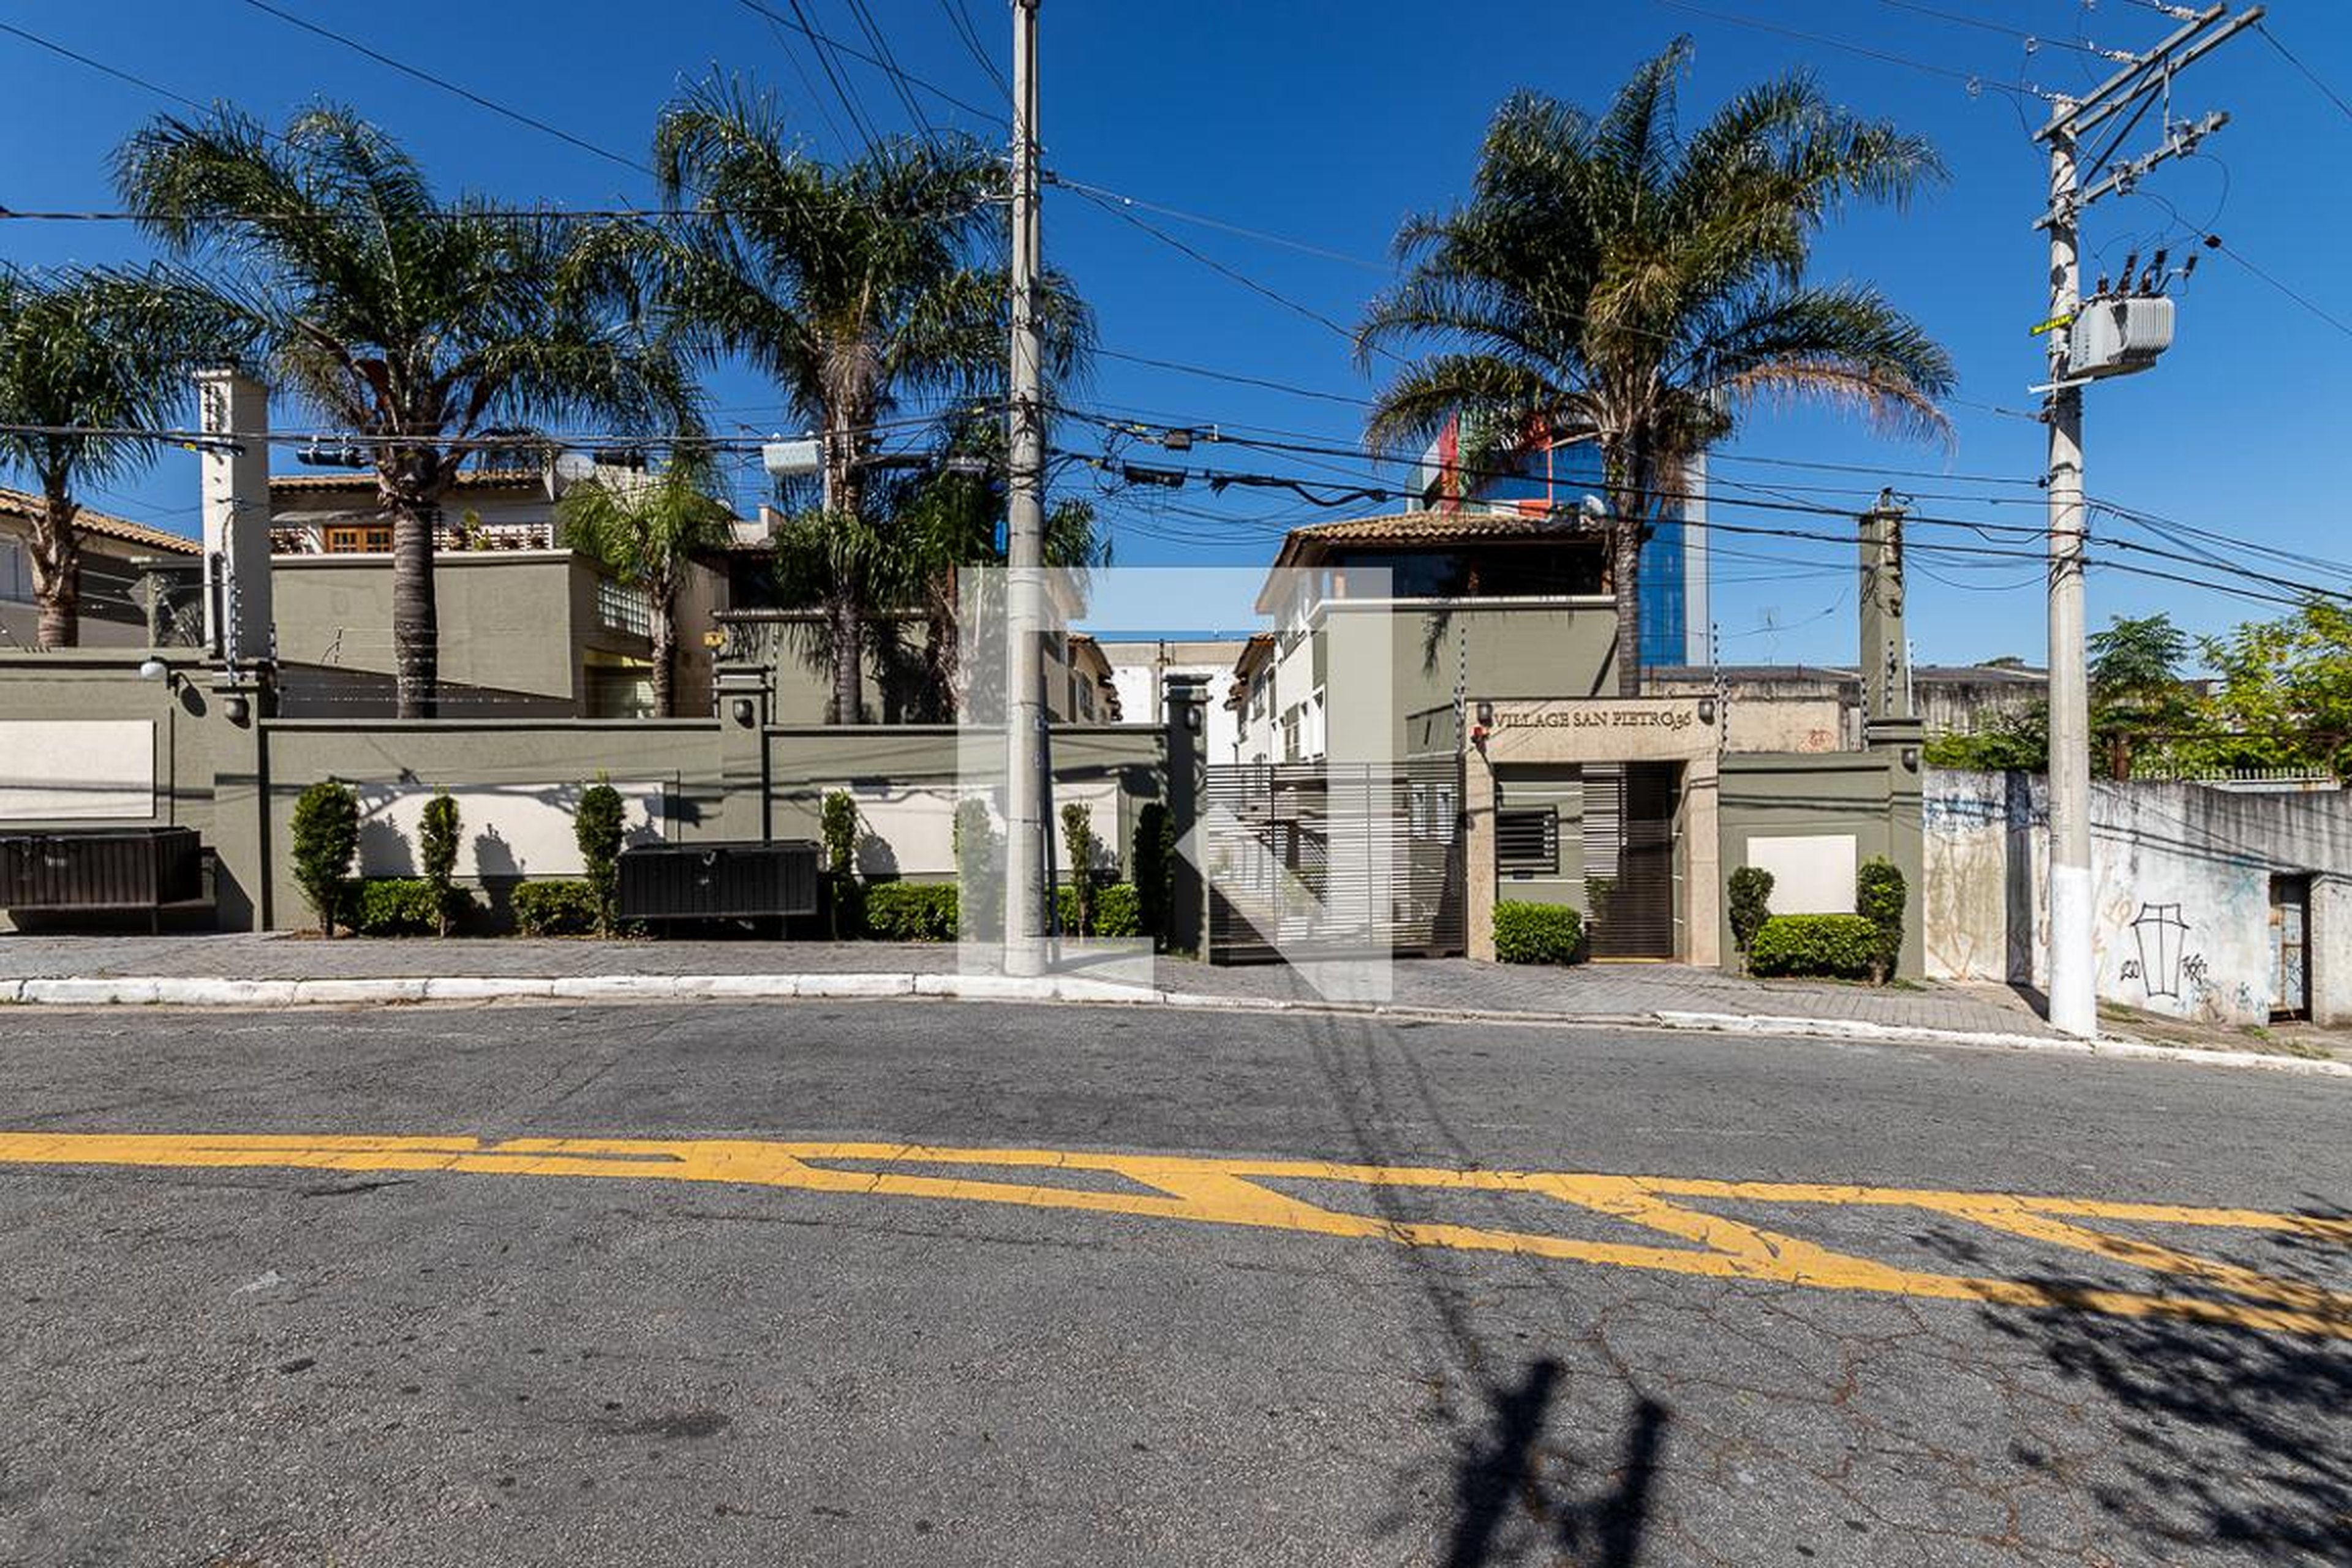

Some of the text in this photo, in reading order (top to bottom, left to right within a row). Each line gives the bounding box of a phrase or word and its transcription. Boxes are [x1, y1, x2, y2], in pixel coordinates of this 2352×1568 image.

[1494, 712, 1569, 728] VILLAGE
[1574, 712, 1608, 727] SAN
[1612, 712, 1675, 727] PIETRO
